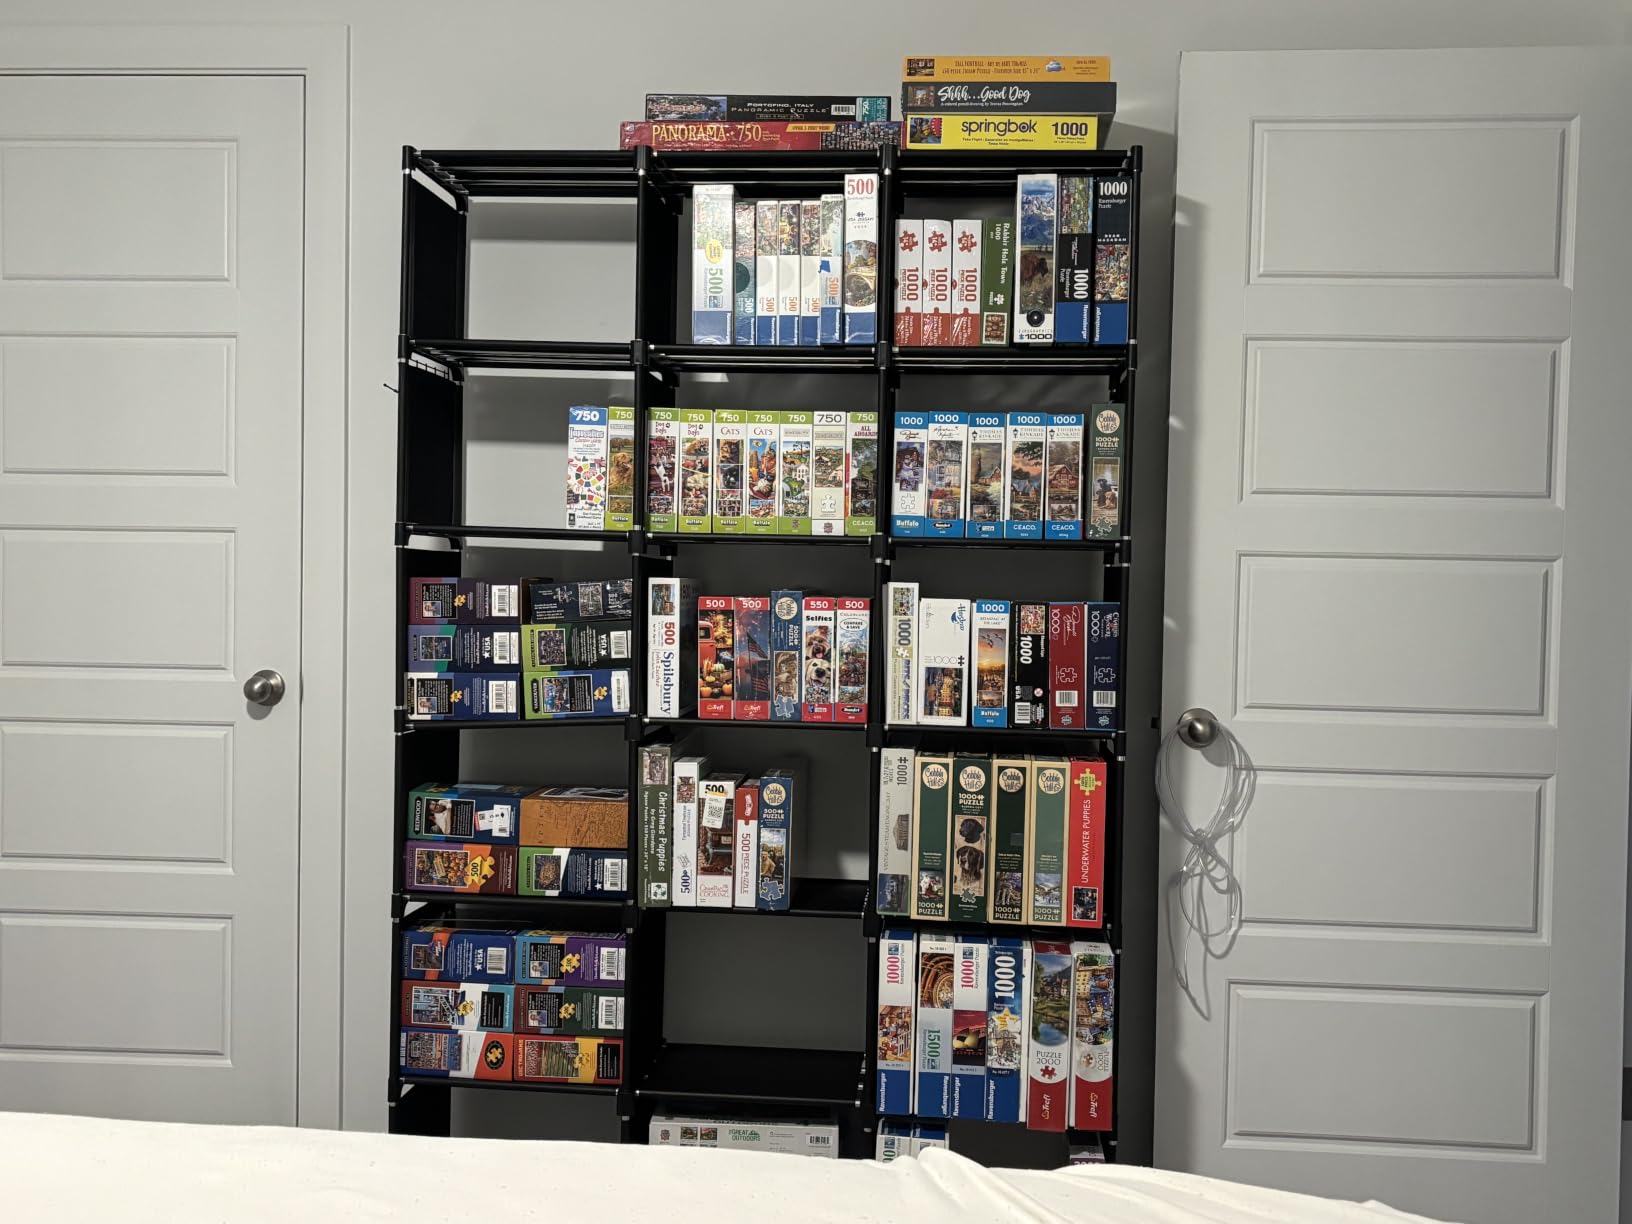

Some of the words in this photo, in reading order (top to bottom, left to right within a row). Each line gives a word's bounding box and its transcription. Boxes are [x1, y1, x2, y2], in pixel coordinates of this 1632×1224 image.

[1009, 86, 1031, 102] Dog
[652, 124, 726, 143] PANORAMA
[735, 124, 762, 143] 750
[961, 119, 1038, 137] springbok
[1051, 122, 1088, 137] 1000
[847, 178, 874, 195] 500
[1099, 181, 1128, 197] 1000
[1002, 222, 1010, 246] Rabbit
[1001, 248, 1009, 264] Hole
[709, 268, 723, 295] 500
[1000, 266, 1008, 284] Town
[829, 277, 839, 296] 500
[907, 267, 918, 301] 1000
[936, 267, 947, 301] 1000
[965, 267, 976, 301] 1000
[1073, 268, 1089, 300] 1000
[745, 297, 754, 313] 500
[766, 297, 775, 313] 500
[789, 296, 797, 312] 500
[812, 297, 820, 313] 500
[574, 411, 600, 422] 750
[615, 412, 633, 420] 750
[654, 411, 673, 420] 750
[687, 413, 705, 422] 750
[721, 413, 740, 422] 750
[754, 414, 773, 422] 750
[787, 414, 806, 422] 750
[818, 414, 842, 423] 750
[857, 413, 874, 421] 750
[900, 416, 924, 425] 1000
[934, 414, 959, 423] 1000
[975, 417, 999, 425] 1000
[1017, 416, 1040, 424] 1000
[1053, 415, 1077, 424] 1000
[655, 421, 666, 429] Dog
[753, 427, 773, 436] CATS
[896, 519, 919, 527] Buffalo
[706, 600, 726, 608] 500
[742, 600, 762, 609] 500
[809, 601, 829, 609] 550
[844, 601, 864, 609] 500
[981, 603, 1005, 613] 1000
[806, 615, 833, 623] Selfies
[1051, 608, 1060, 634] 1000
[1091, 610, 1100, 636] 1000
[664, 621, 675, 646] 500
[898, 618, 911, 646] 1000
[1020, 635, 1032, 664] 1000
[660, 651, 675, 714] Spilsbury
[980, 710, 1000, 718] Buffalo
[896, 764, 907, 786] 1000
[704, 784, 725, 794] 500
[658, 791, 669, 835] Christmas
[1083, 799, 1092, 829] PUPPIES
[742, 833, 751, 852] 500
[656, 837, 669, 872] Puppies
[1081, 831, 1090, 883] UNDERWATER
[471, 862, 479, 877] 500
[680, 873, 691, 894] 500
[918, 908, 943, 916] PUZZLE
[995, 912, 1020, 920] PUZZLE
[1034, 913, 1059, 921] PUZZLE
[565, 957, 573, 967] 500
[886, 956, 900, 985] 1000
[961, 960, 974, 989] 1000
[995, 955, 1016, 999] 1000
[927, 1029, 941, 1058] 1500
[1036, 1050, 1062, 1060] PUZZLE
[1036, 1058, 1061, 1067] 2000
[941, 1075, 949, 1116] Ravensburger
[987, 1080, 995, 1120] Ravensburger
[1042, 1095, 1050, 1110] Trefl
[1090, 1101, 1098, 1118] Trefl
[731, 1128, 748, 1136] GREAT
[731, 1134, 761, 1142] OUTDOORS
